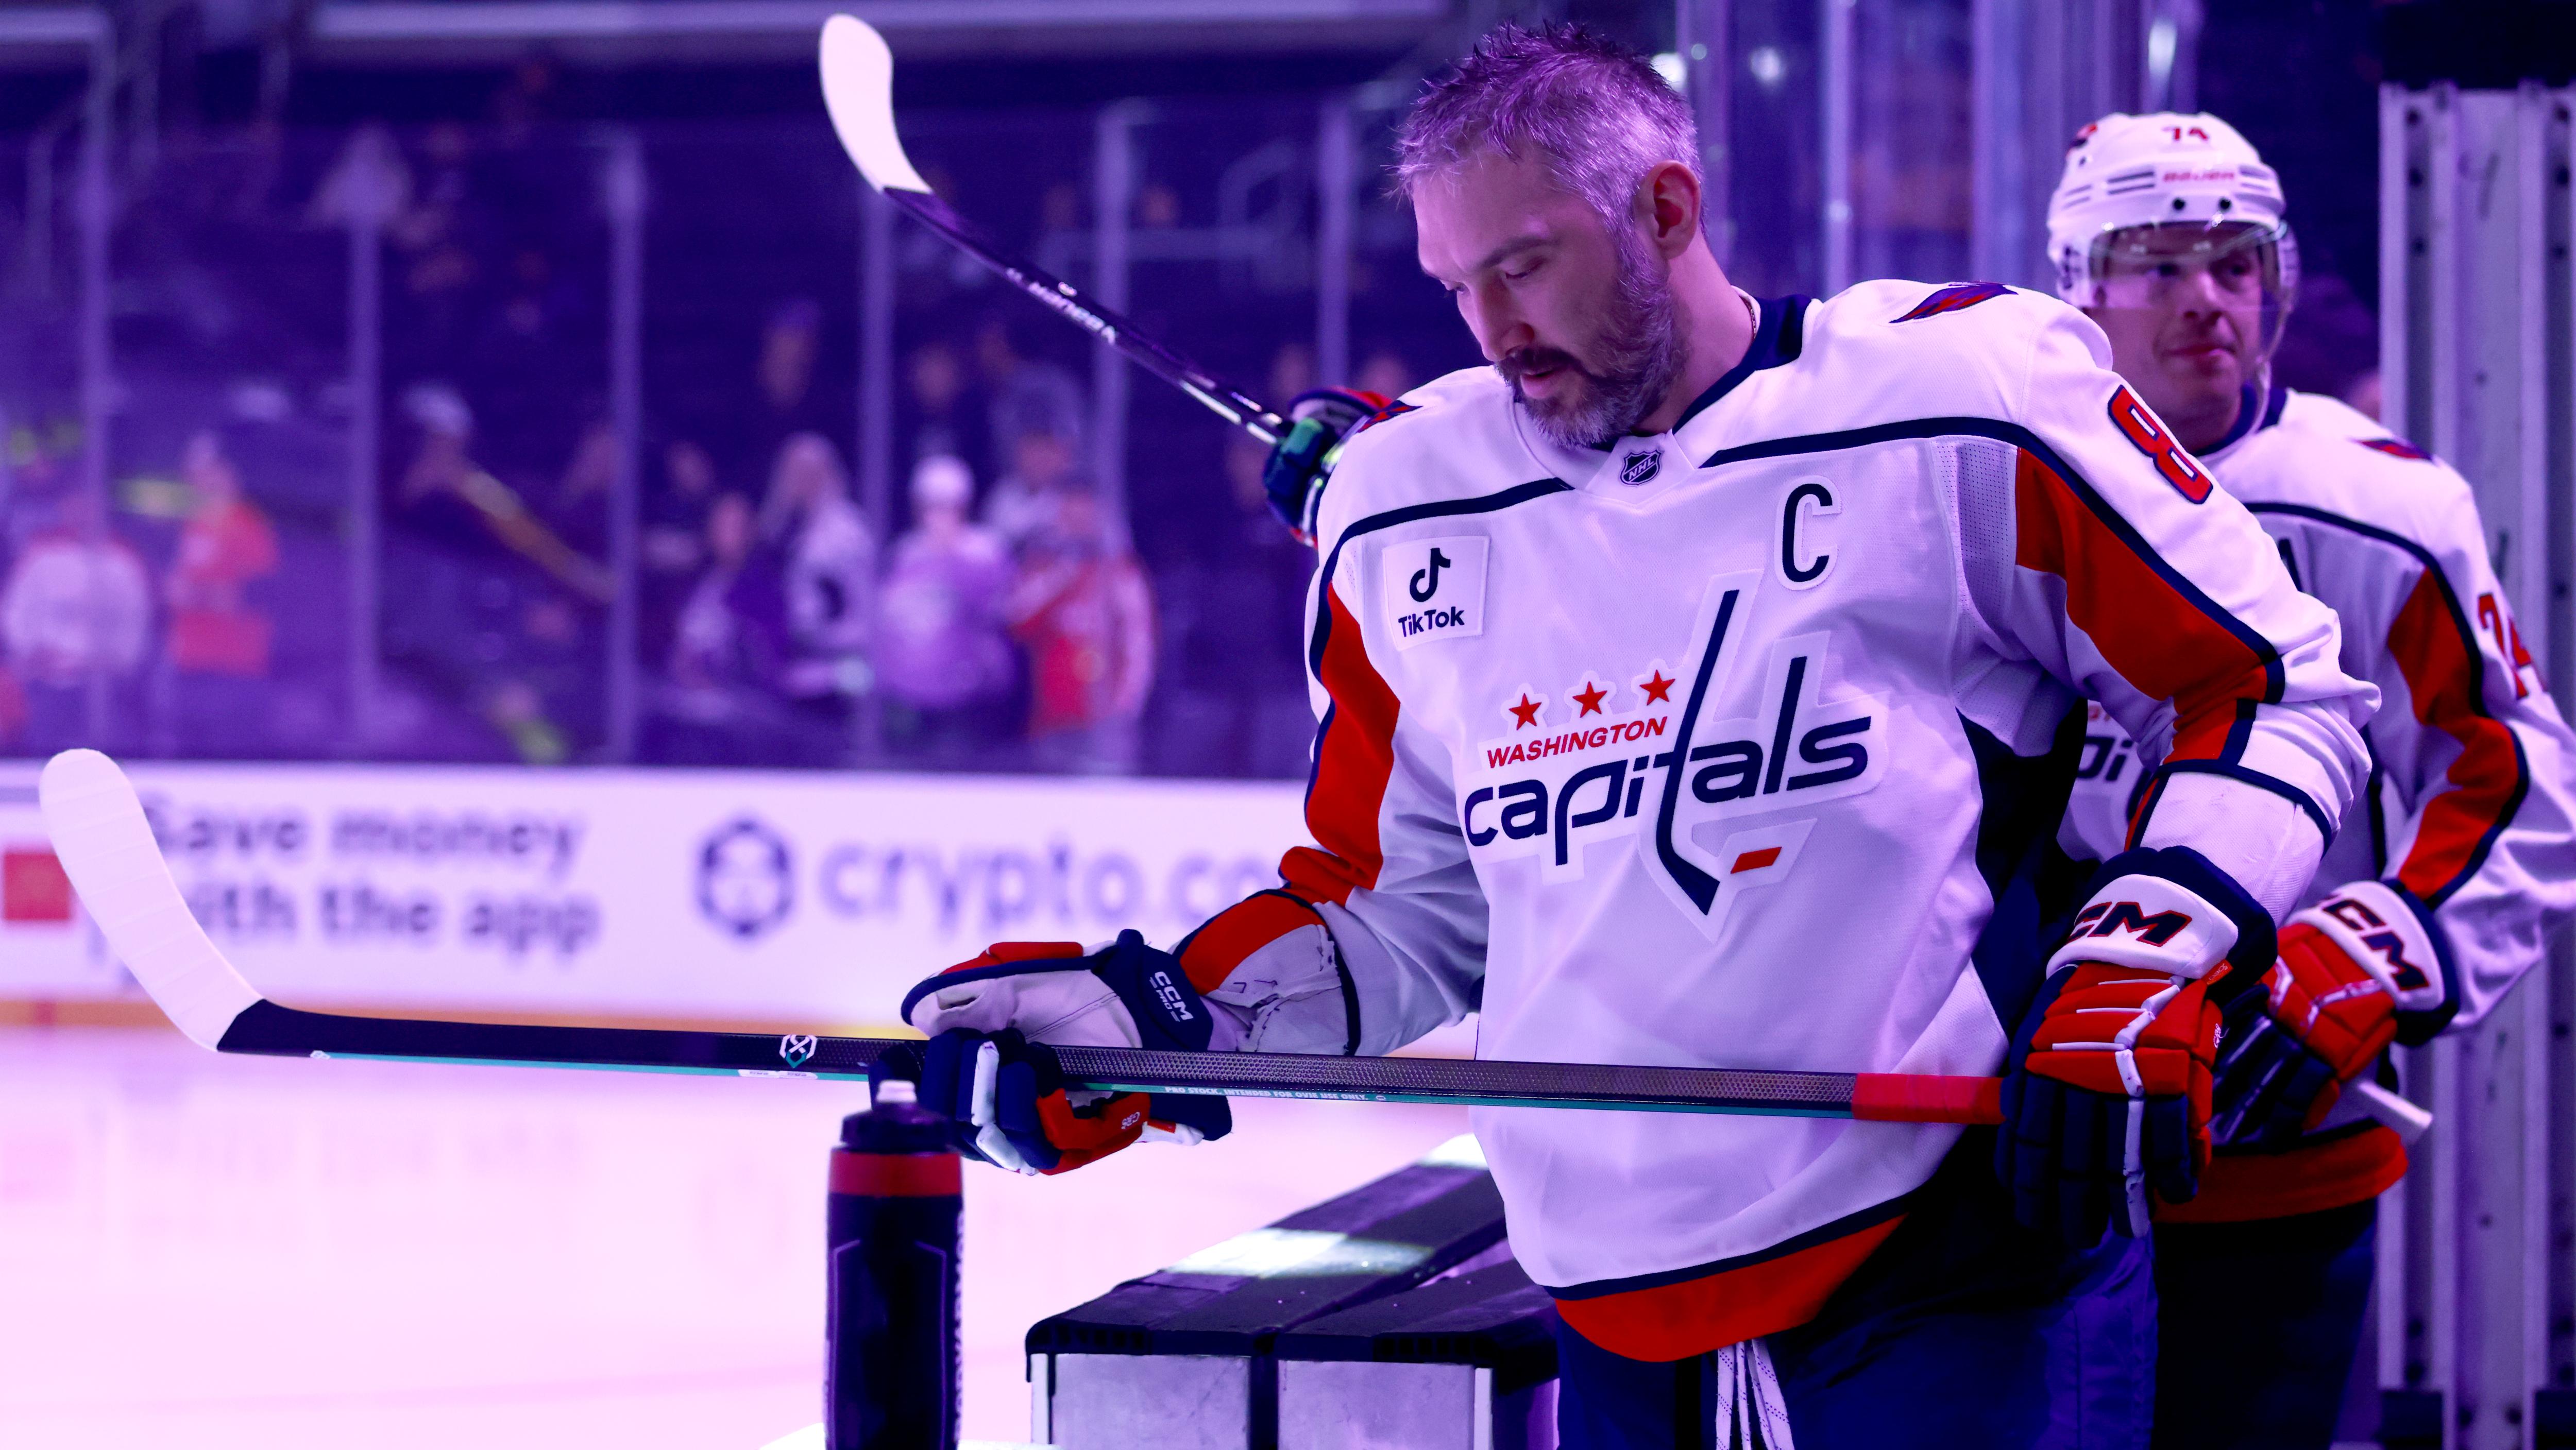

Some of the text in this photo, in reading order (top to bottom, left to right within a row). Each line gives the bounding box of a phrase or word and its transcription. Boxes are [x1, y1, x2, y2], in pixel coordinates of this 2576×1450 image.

[1629, 458, 1654, 480] NHL
[2107, 385, 2213, 504] 8
[1782, 483, 1833, 583] C
[1398, 606, 1465, 637] TikTok
[1487, 717, 1668, 768] WASHINGTON
[331, 815, 585, 882] money
[321, 879, 437, 936] the
[465, 899, 601, 964] app
[2066, 901, 2192, 947] CM
[2322, 894, 2430, 991] CM
[1155, 971, 1194, 1020] CCM
[1155, 990, 1173, 1010] PRO
